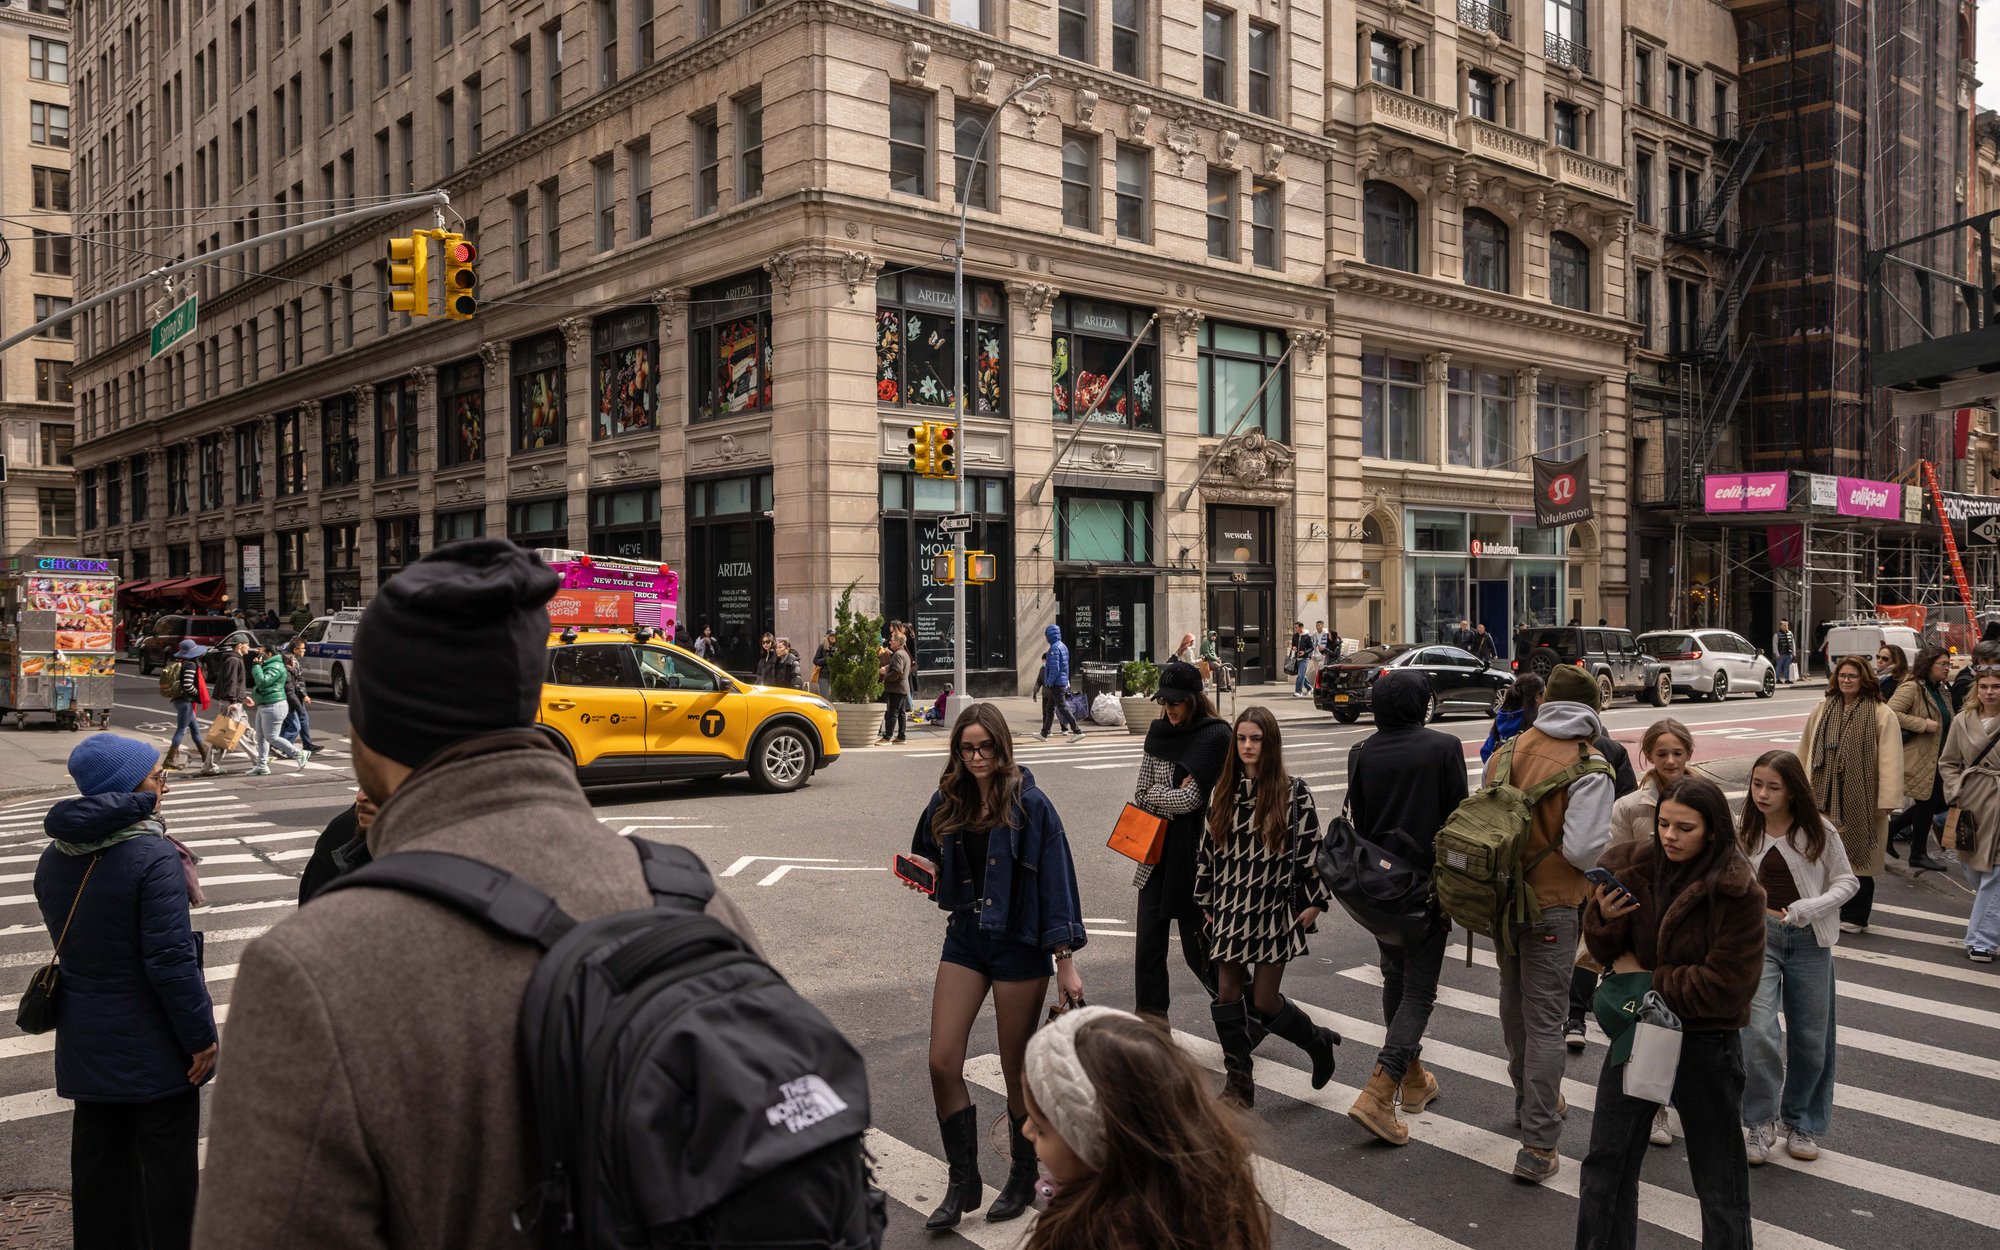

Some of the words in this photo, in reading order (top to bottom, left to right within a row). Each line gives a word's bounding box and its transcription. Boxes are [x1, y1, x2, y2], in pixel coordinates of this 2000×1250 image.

[725, 284, 753, 300] ARITZIA
[918, 289, 956, 304] ARITZIA
[160, 320, 177, 347] Spring
[177, 311, 183, 332] St
[1083, 315, 1117, 329] ARITZIA
[1541, 507, 1590, 525] lululemon
[943, 520, 952, 528] ONE
[1224, 530, 1252, 540] wework
[619, 543, 641, 555] WE'VE
[1482, 542, 1519, 555] lululemon
[40, 559, 108, 571] CHICKEN
[718, 562, 752, 577] ARITZIA
[612, 578, 634, 586] YORK
[1234, 573, 1247, 581] 524
[634, 591, 658, 599] TRUCK
[706, 715, 720, 735] T
[779, 1077, 808, 1099] THE
[766, 1094, 816, 1126] NORTH
[785, 1106, 826, 1133] FACE
